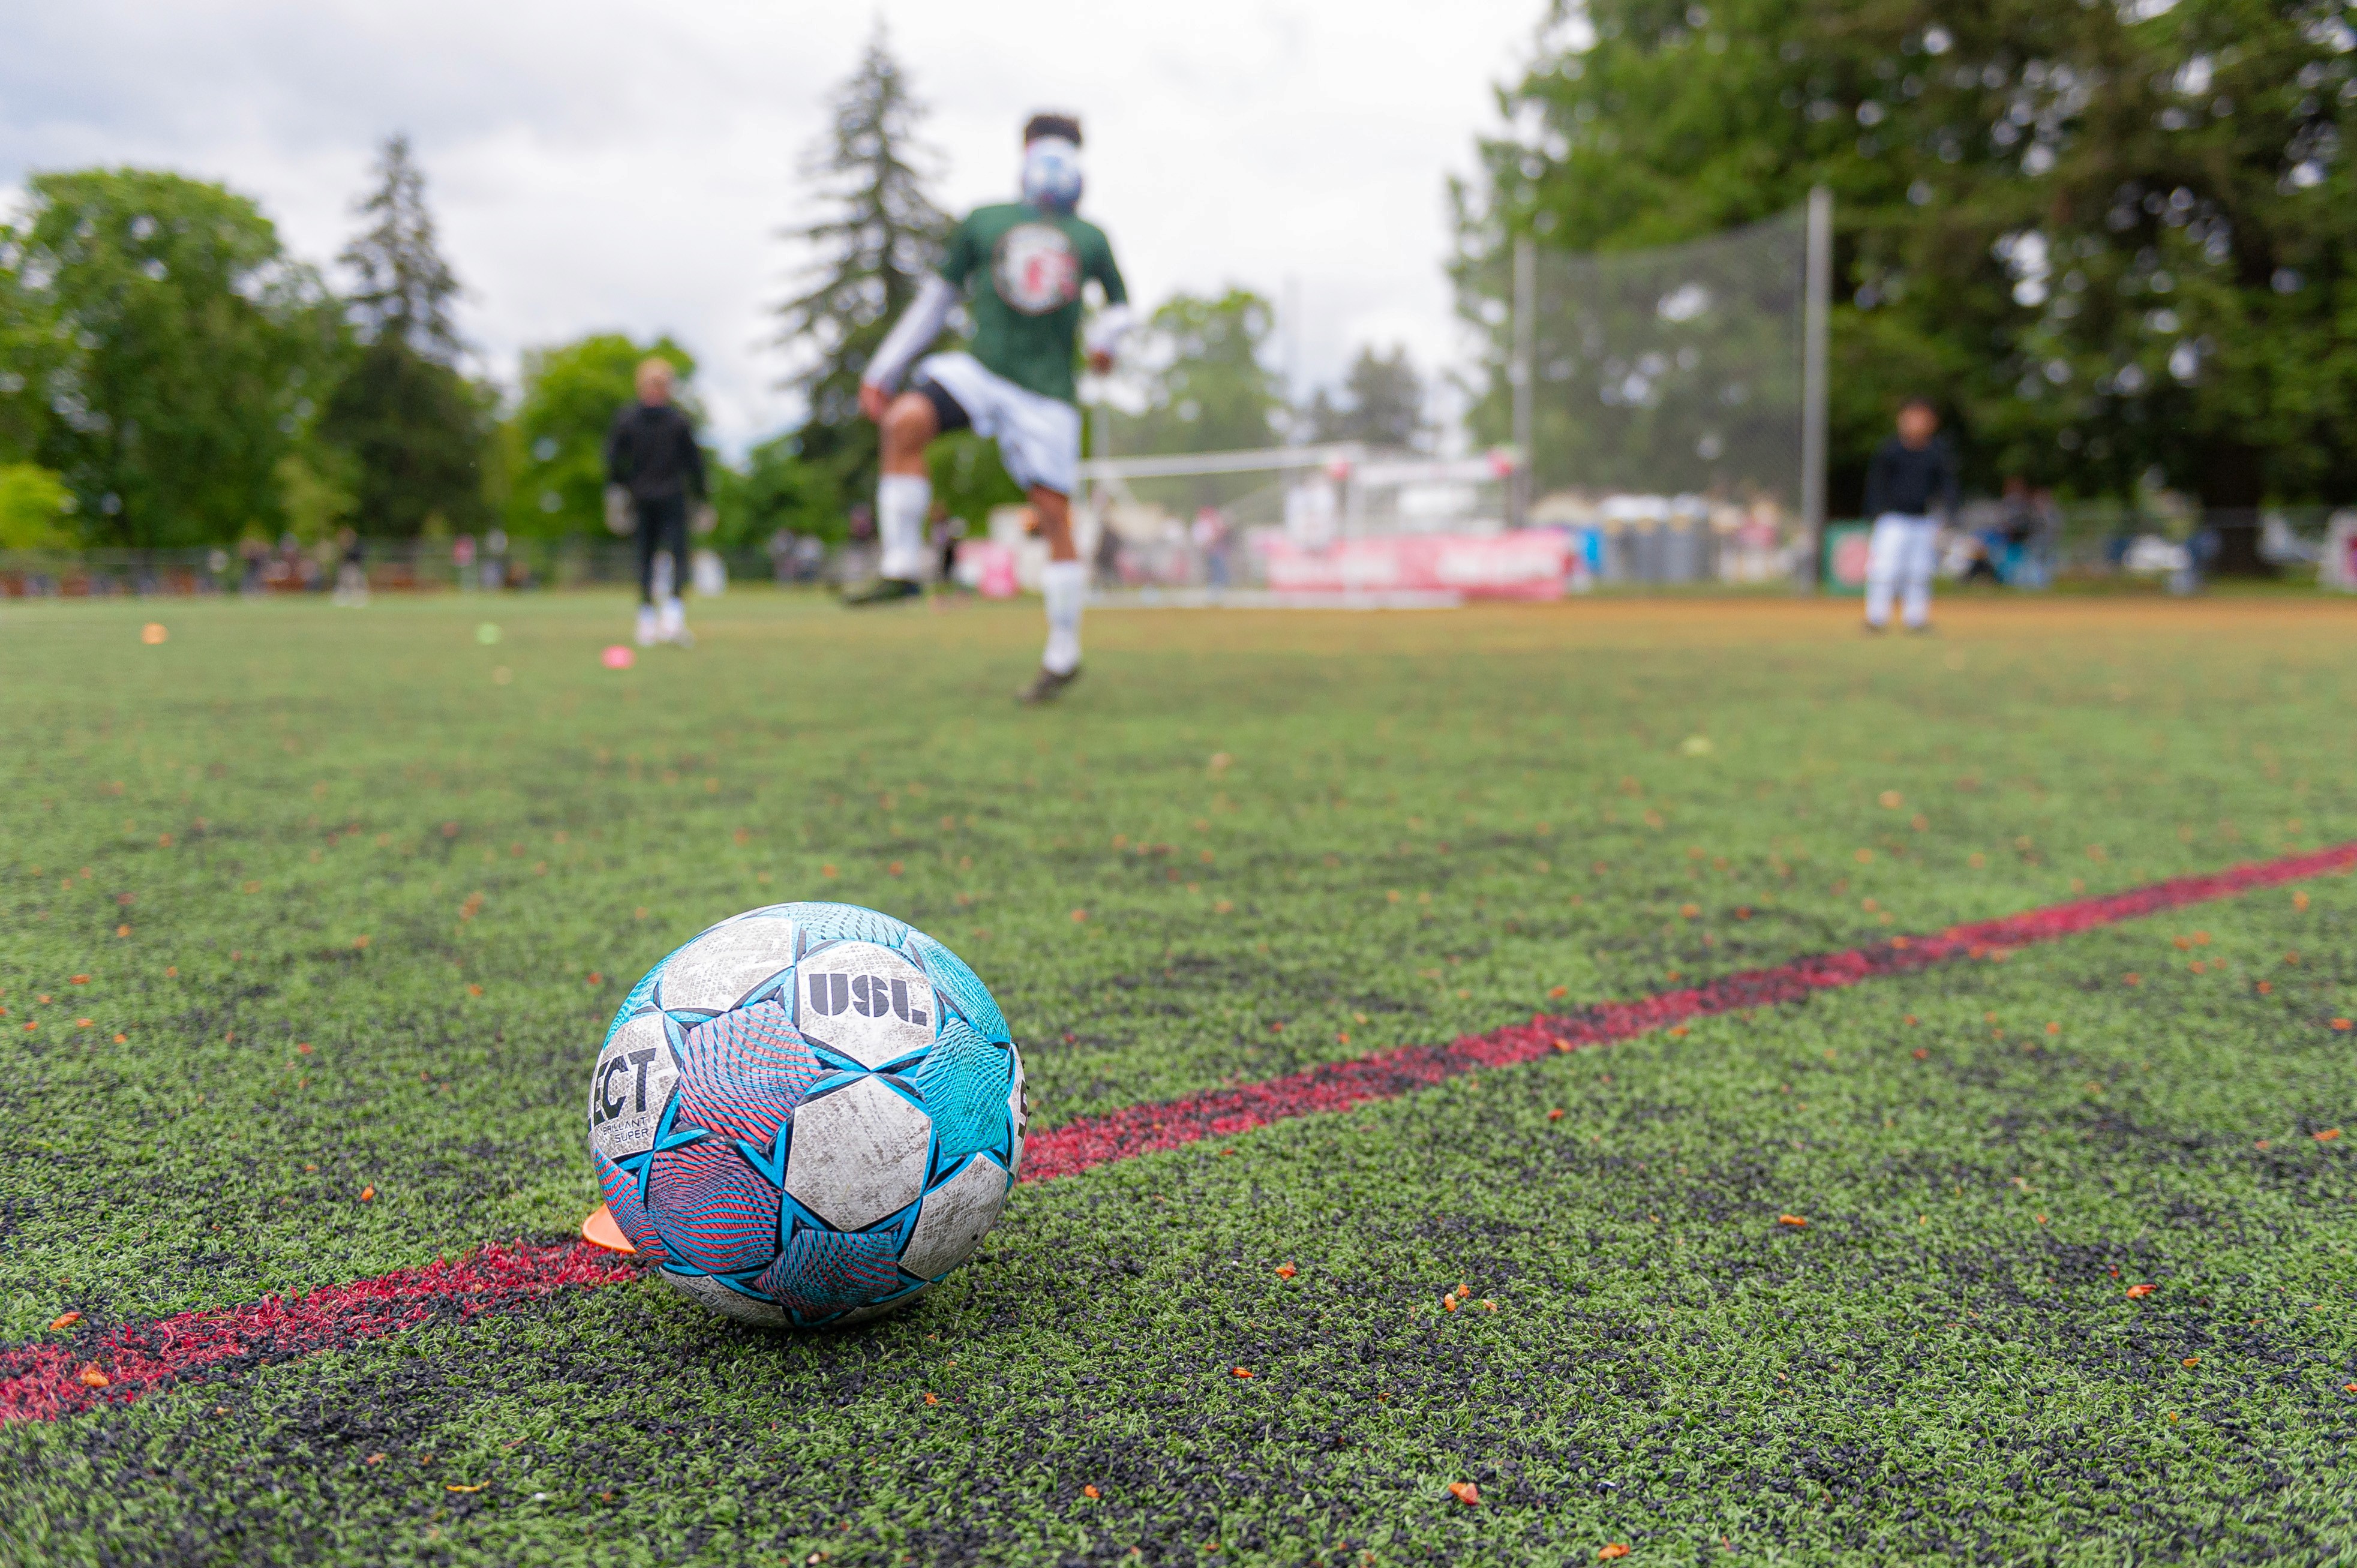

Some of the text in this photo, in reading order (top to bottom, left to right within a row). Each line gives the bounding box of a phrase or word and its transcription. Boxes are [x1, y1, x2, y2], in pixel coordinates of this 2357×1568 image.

[809, 974, 927, 1026] USL
[589, 1048, 656, 1130] ECT
[603, 1116, 648, 1136] BRILLANT
[614, 1128, 649, 1143] SUPER
